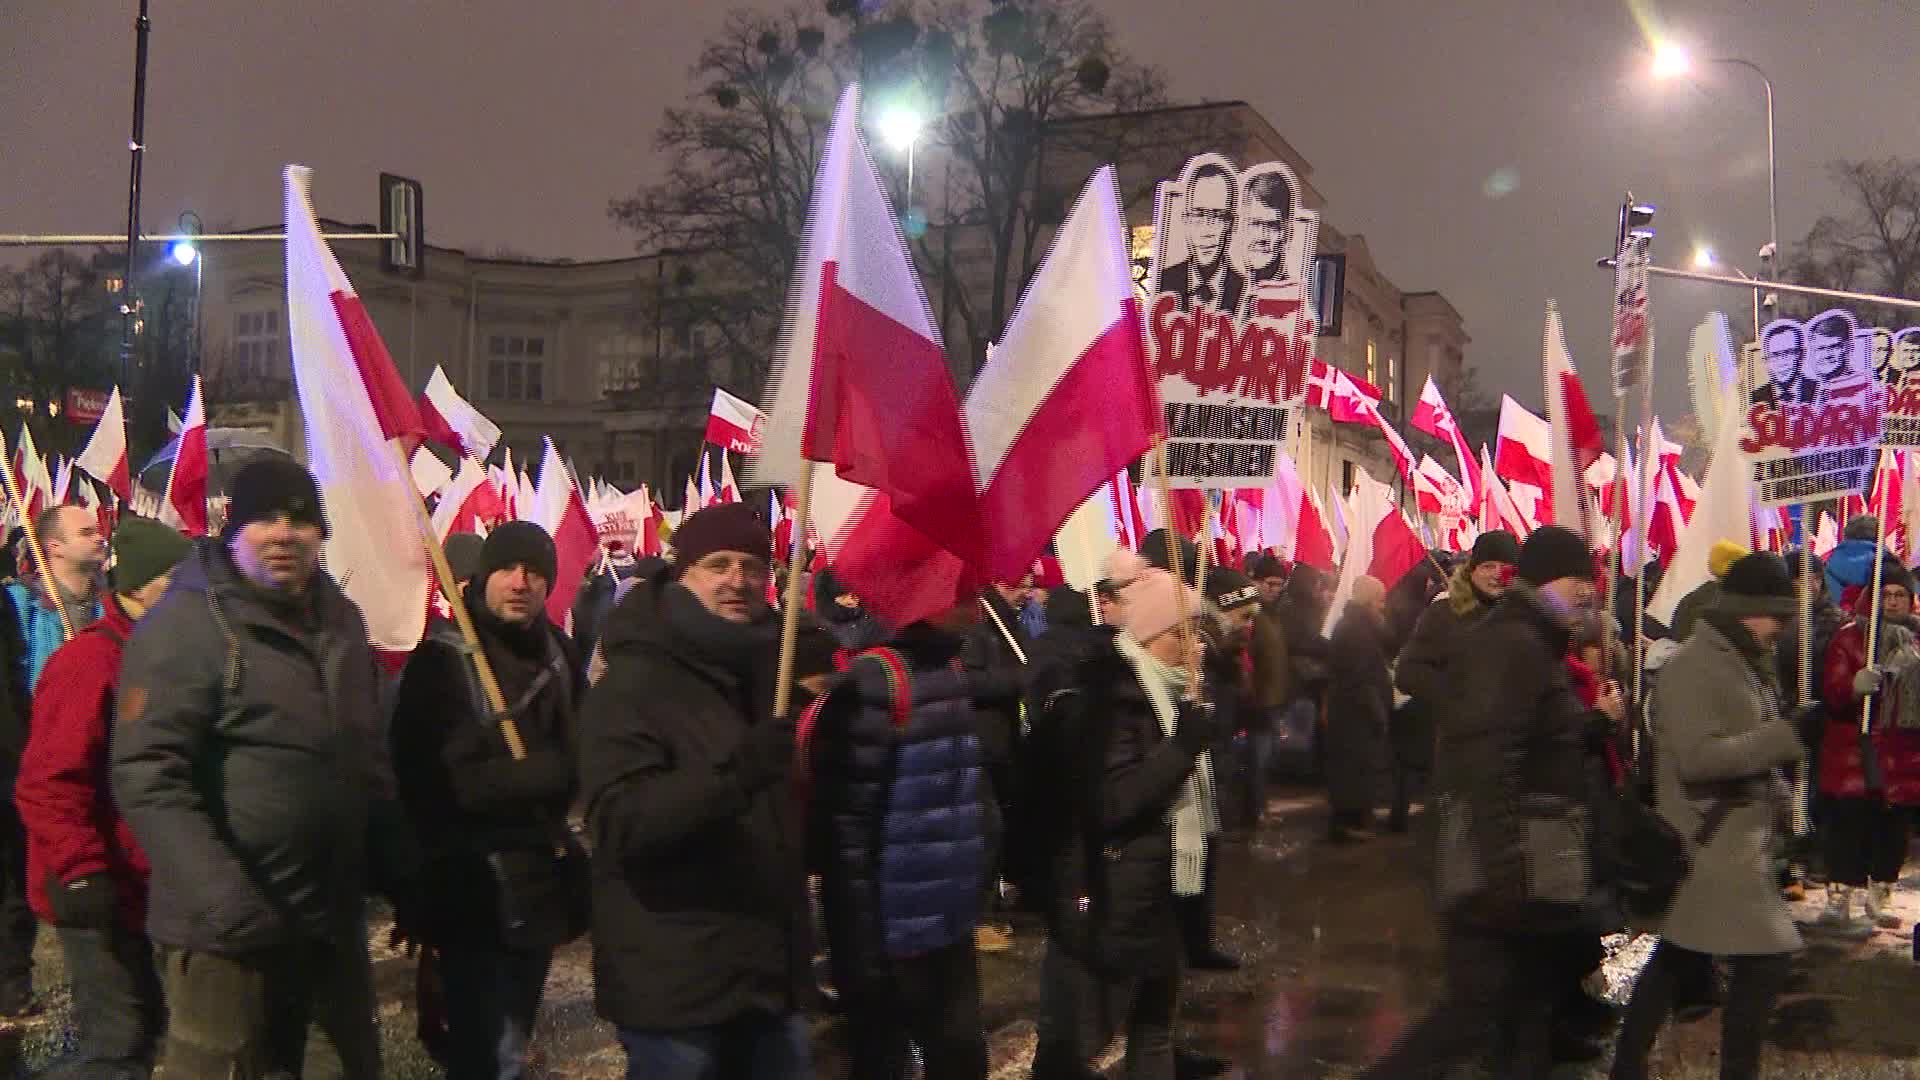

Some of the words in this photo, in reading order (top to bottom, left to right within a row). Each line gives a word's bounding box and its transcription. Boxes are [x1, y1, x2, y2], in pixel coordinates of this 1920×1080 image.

[1164, 398, 1287, 442] KAMIŃSKIM
[1166, 442, 1275, 483] WĄSIKIEM
[1765, 446, 1870, 479] KAMIŃSKIM
